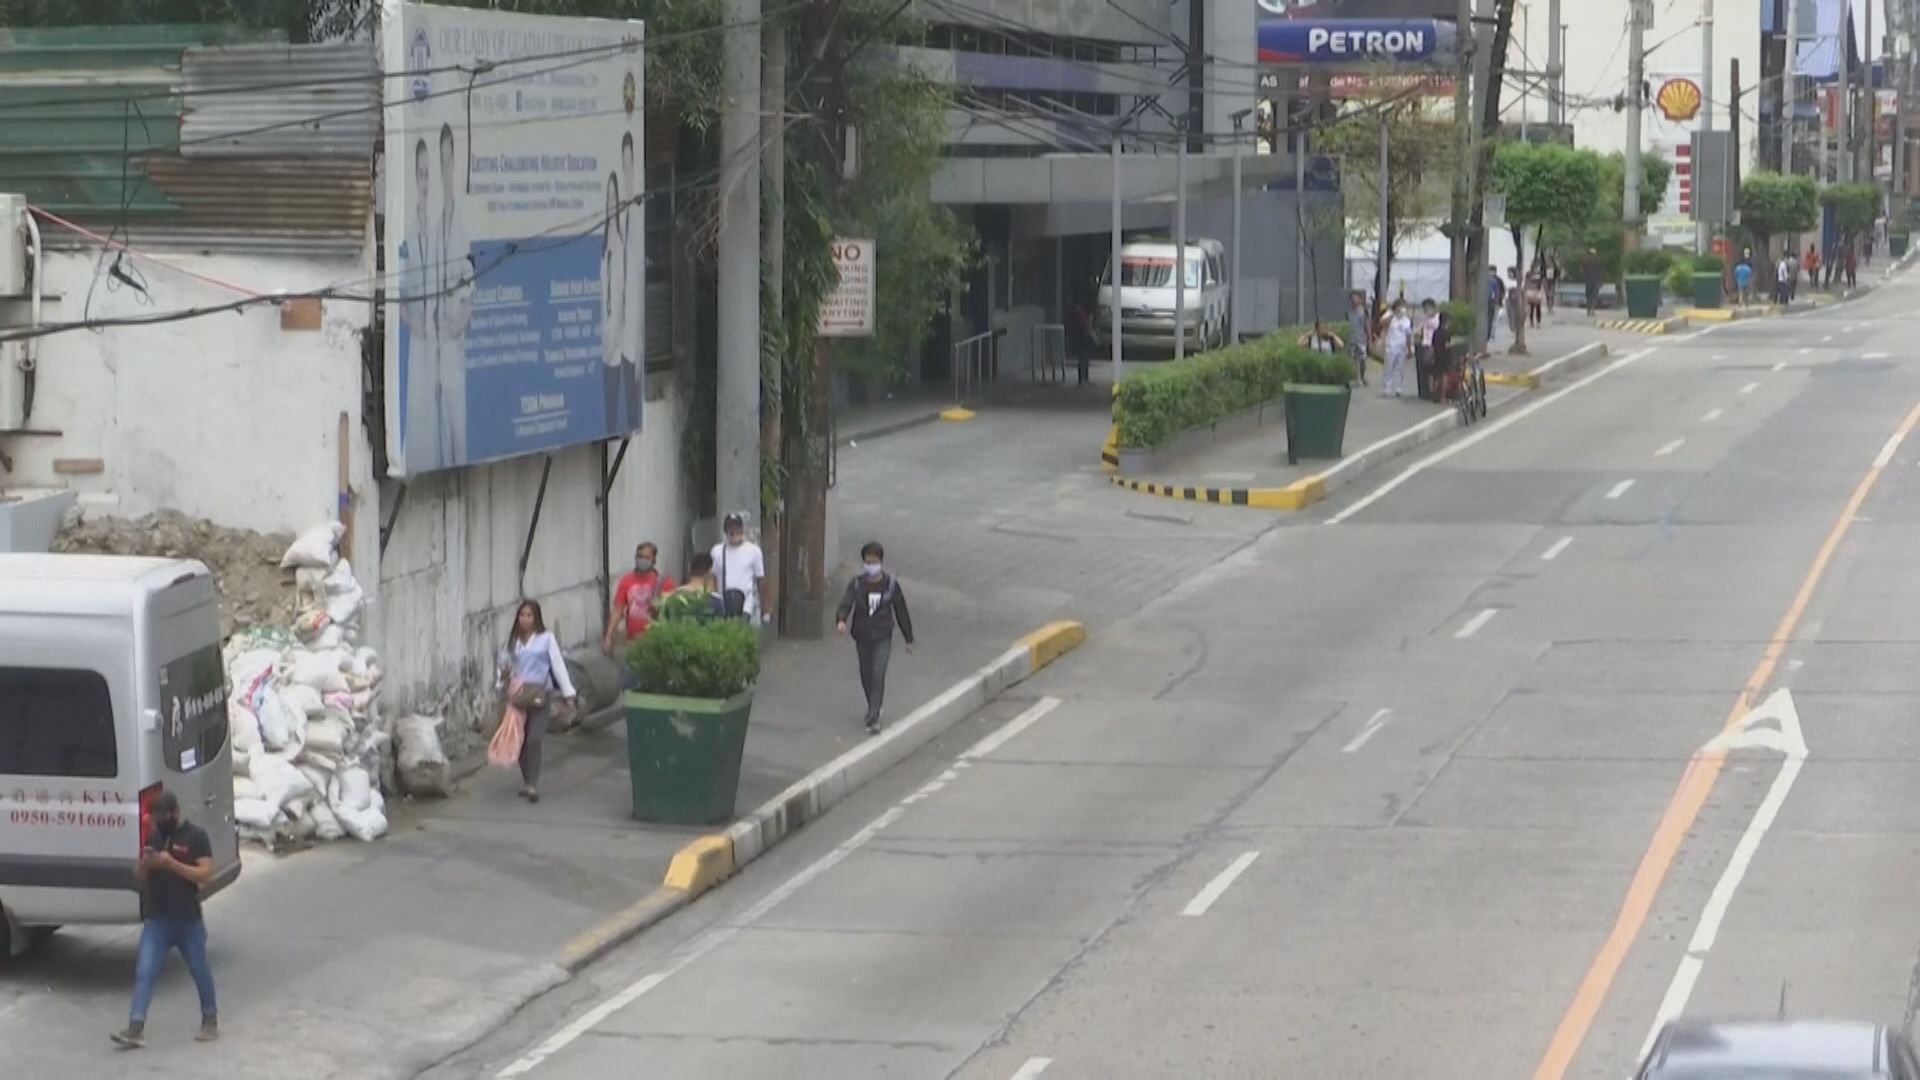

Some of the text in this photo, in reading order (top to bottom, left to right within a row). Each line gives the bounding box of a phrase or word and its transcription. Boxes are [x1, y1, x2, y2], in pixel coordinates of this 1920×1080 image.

[1309, 28, 1424, 53] PETRON
[831, 244, 861, 261] NO
[822, 308, 865, 318] ANYTIME
